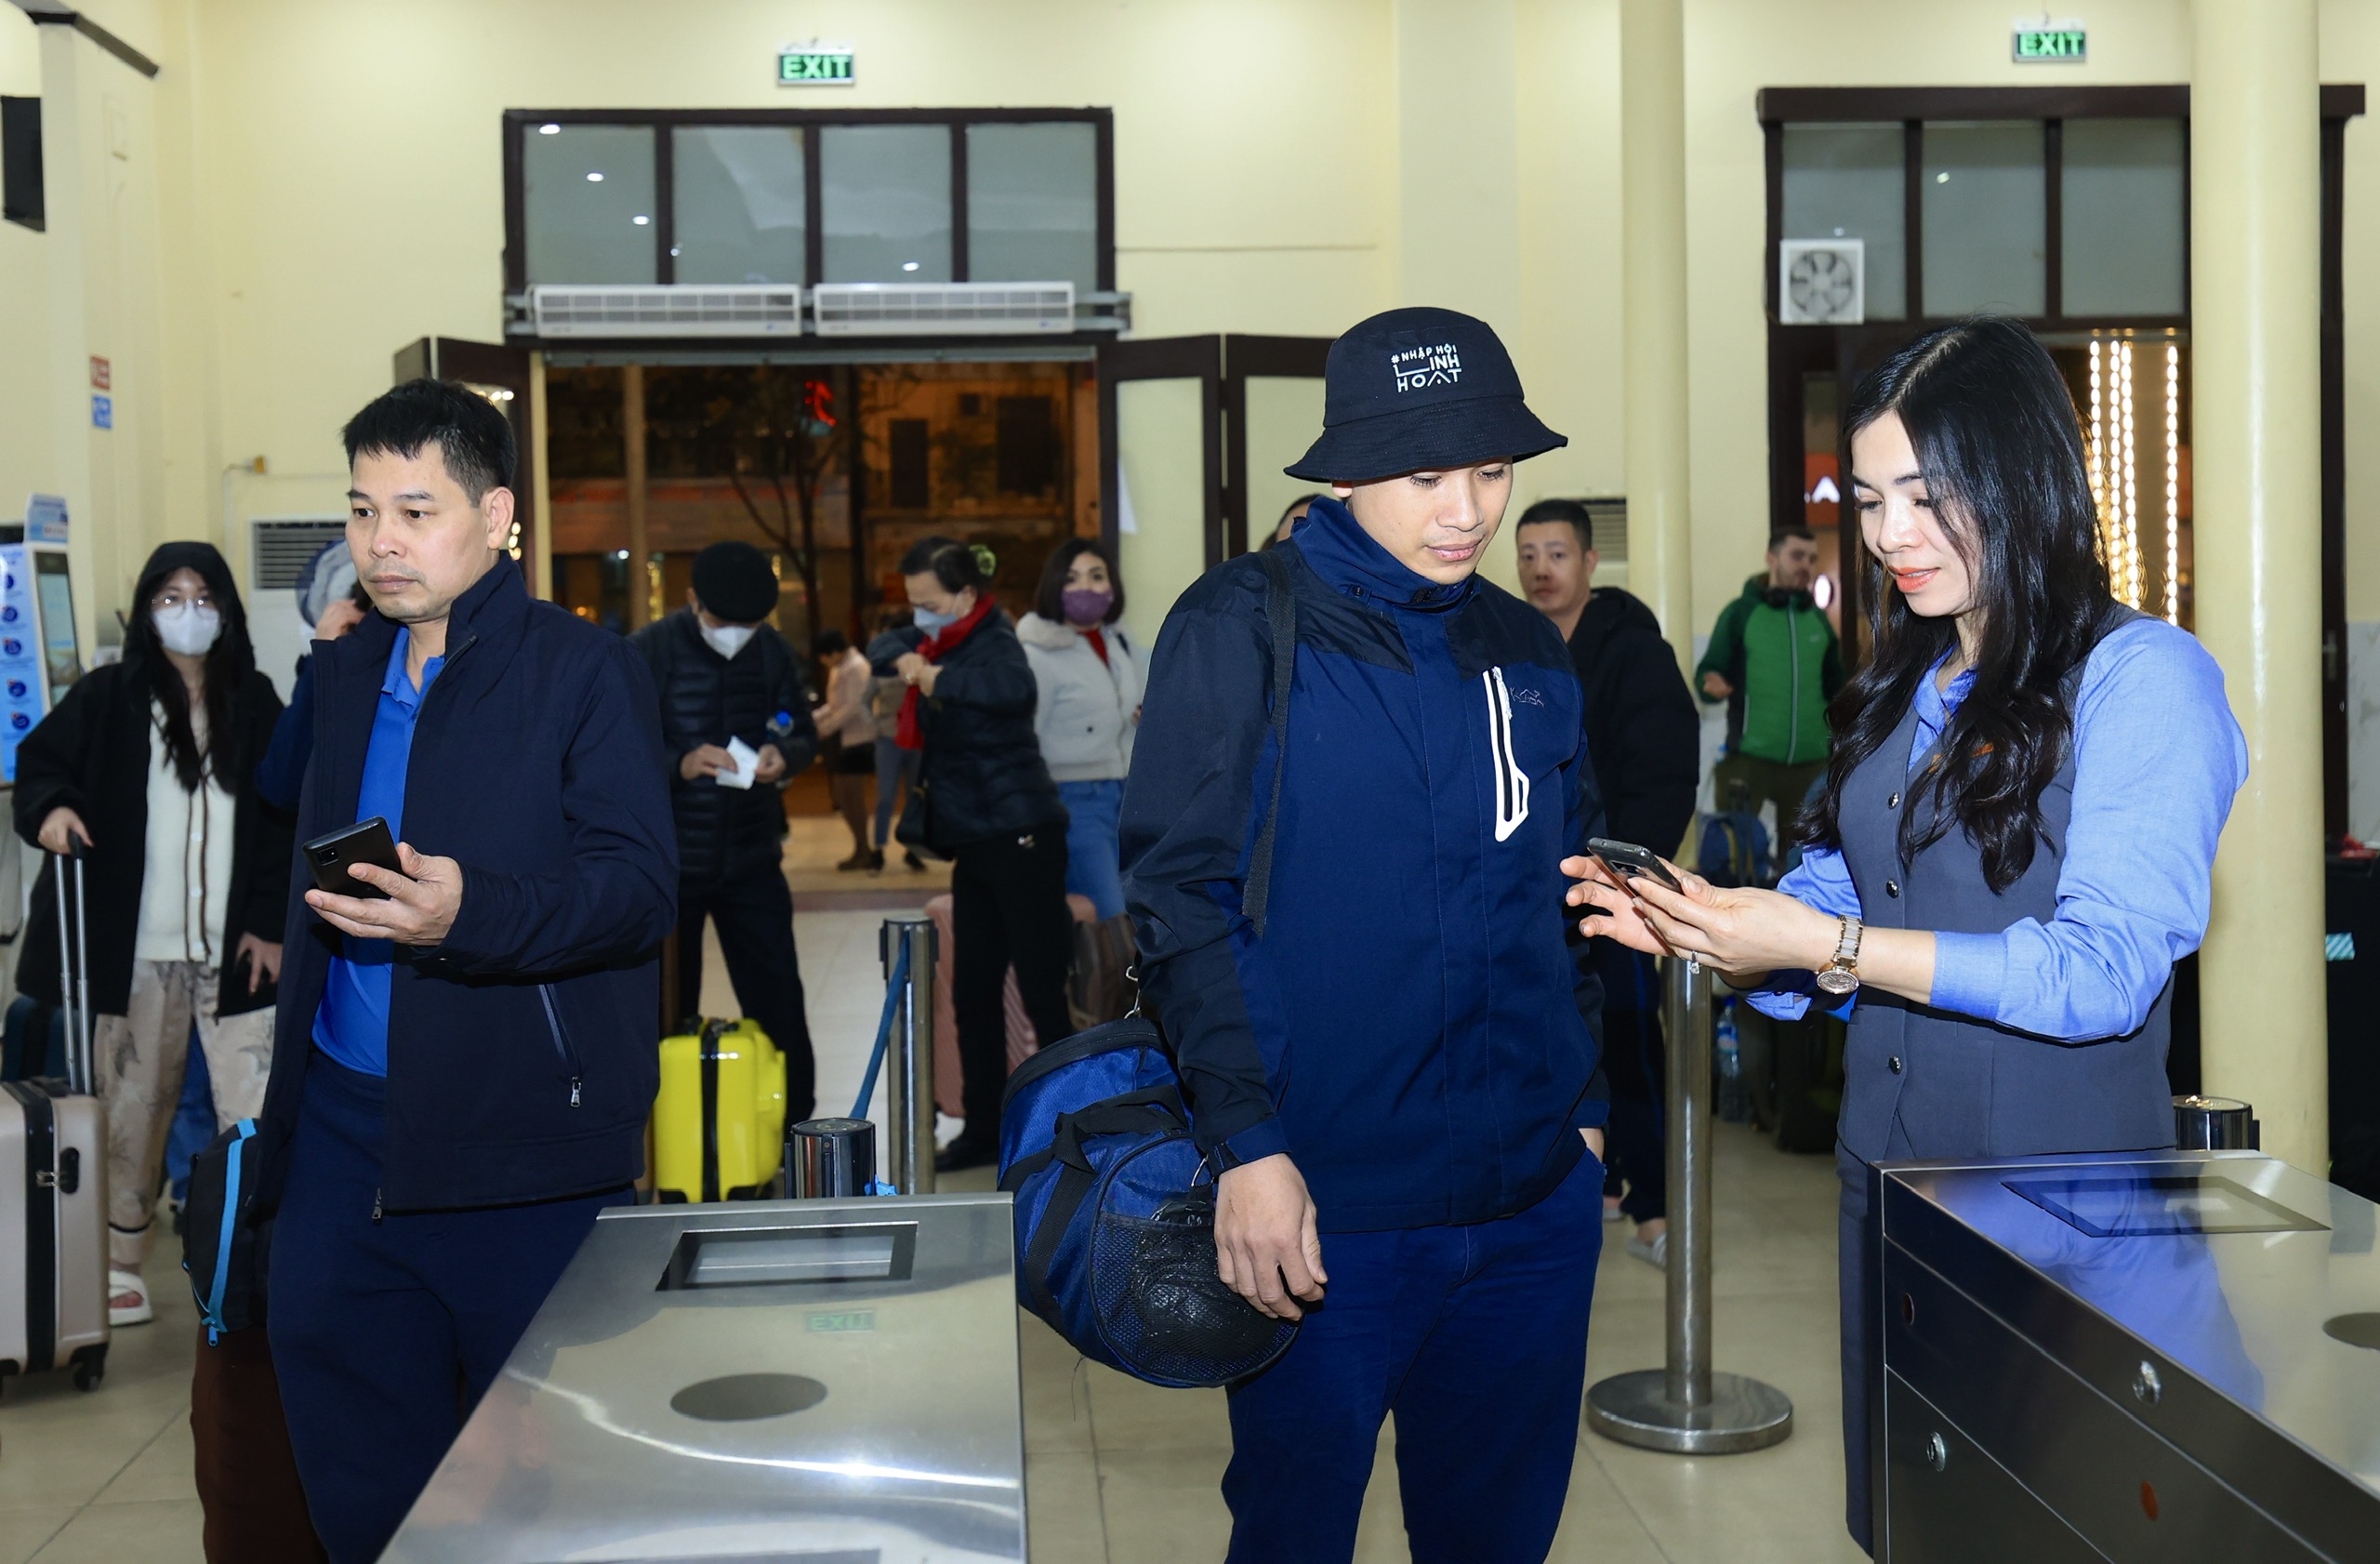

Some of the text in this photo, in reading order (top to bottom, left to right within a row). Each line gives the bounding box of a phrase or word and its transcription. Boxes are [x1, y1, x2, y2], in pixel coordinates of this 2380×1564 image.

[2019, 31, 2084, 57] EXIT
[782, 55, 851, 79] EXIT
[1396, 368, 1462, 393] HOẠT
